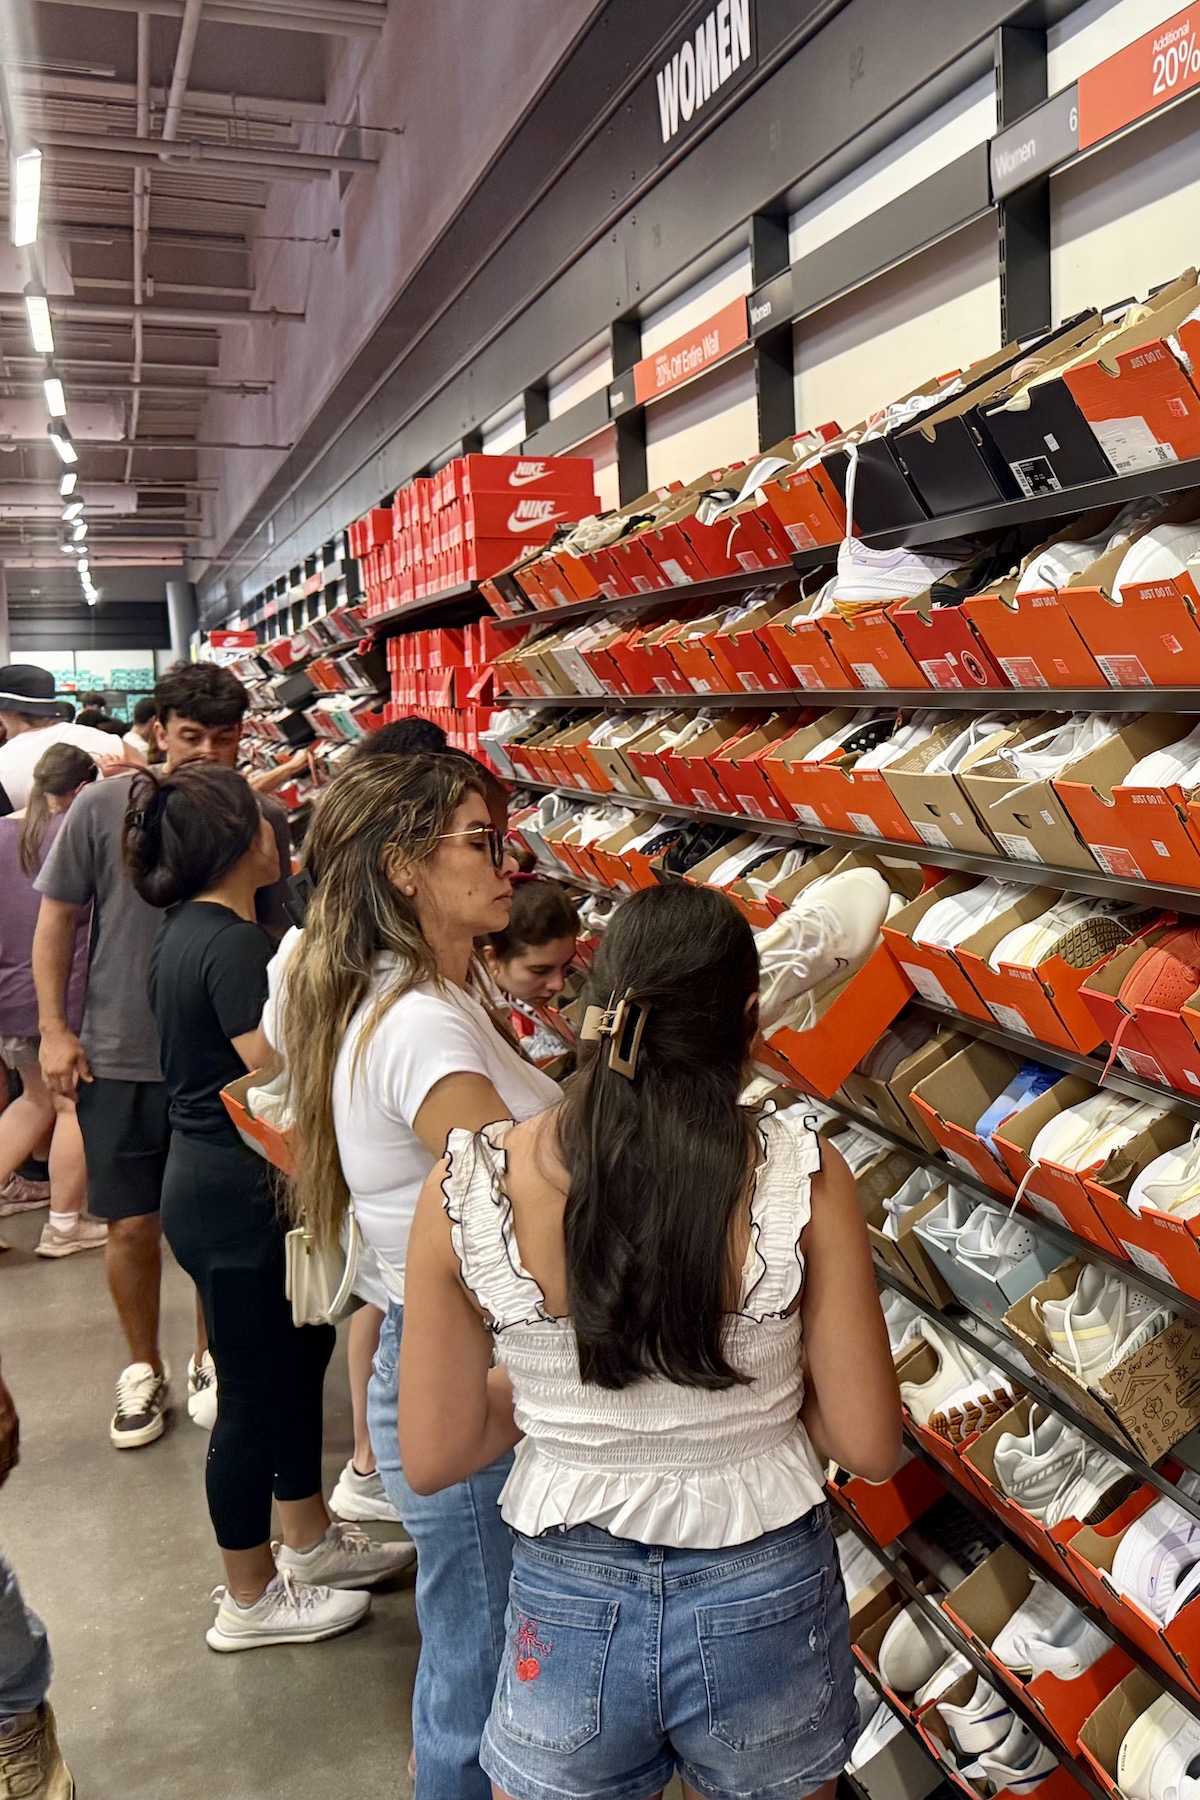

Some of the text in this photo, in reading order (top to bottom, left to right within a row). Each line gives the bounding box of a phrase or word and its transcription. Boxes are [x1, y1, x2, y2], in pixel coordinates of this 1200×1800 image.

[1153, 19, 1190, 54] Additional
[656, 0, 750, 143] WOMEN
[1153, 32, 1200, 96] 20%
[993, 107, 1078, 179] Women 6
[1130, 354, 1146, 369] JUST
[1147, 351, 1158, 364] DO
[515, 462, 546, 476] NIKE
[516, 500, 556, 519] NIKE
[1139, 587, 1155, 600] JUST
[1156, 587, 1166, 598] DO
[1132, 794, 1146, 805] JUST
[1147, 795, 1158, 805] DO
